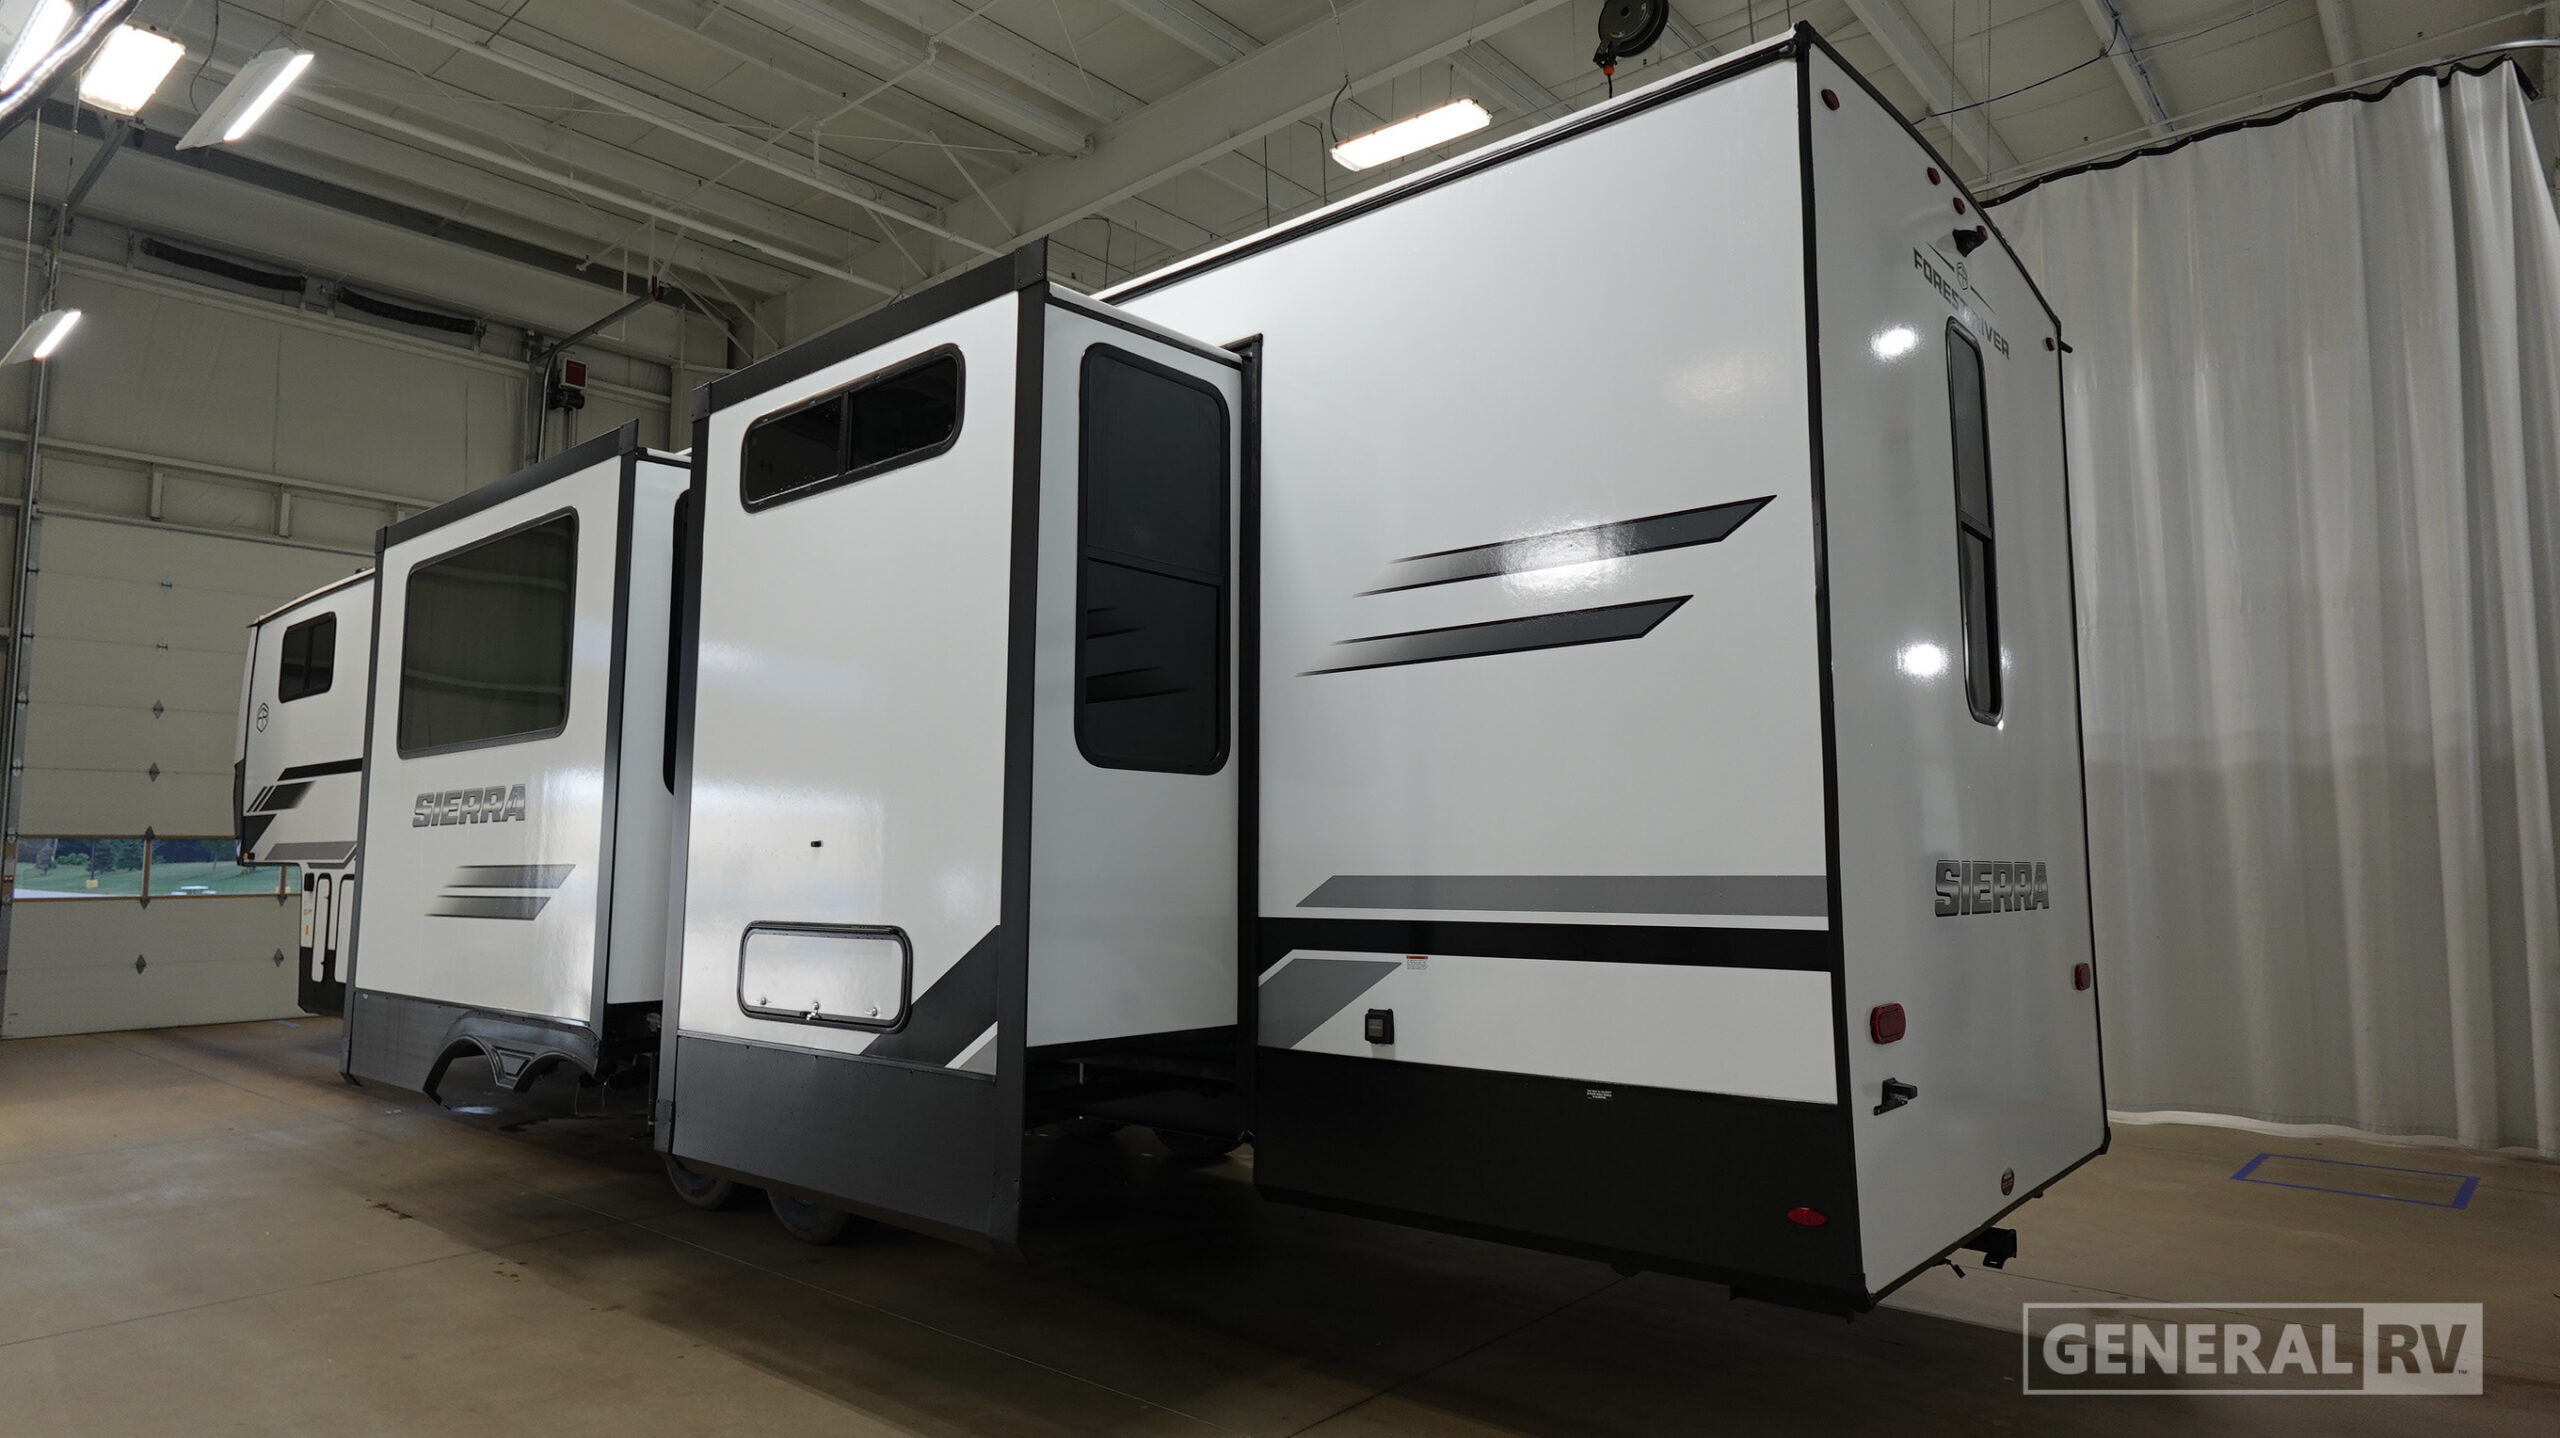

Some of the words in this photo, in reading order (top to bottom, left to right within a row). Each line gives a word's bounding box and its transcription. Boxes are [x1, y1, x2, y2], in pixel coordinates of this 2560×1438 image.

[1913, 247, 1968, 316] FOREST
[412, 784, 526, 828] SIERRA
[1935, 860, 2049, 917] SIERRA
